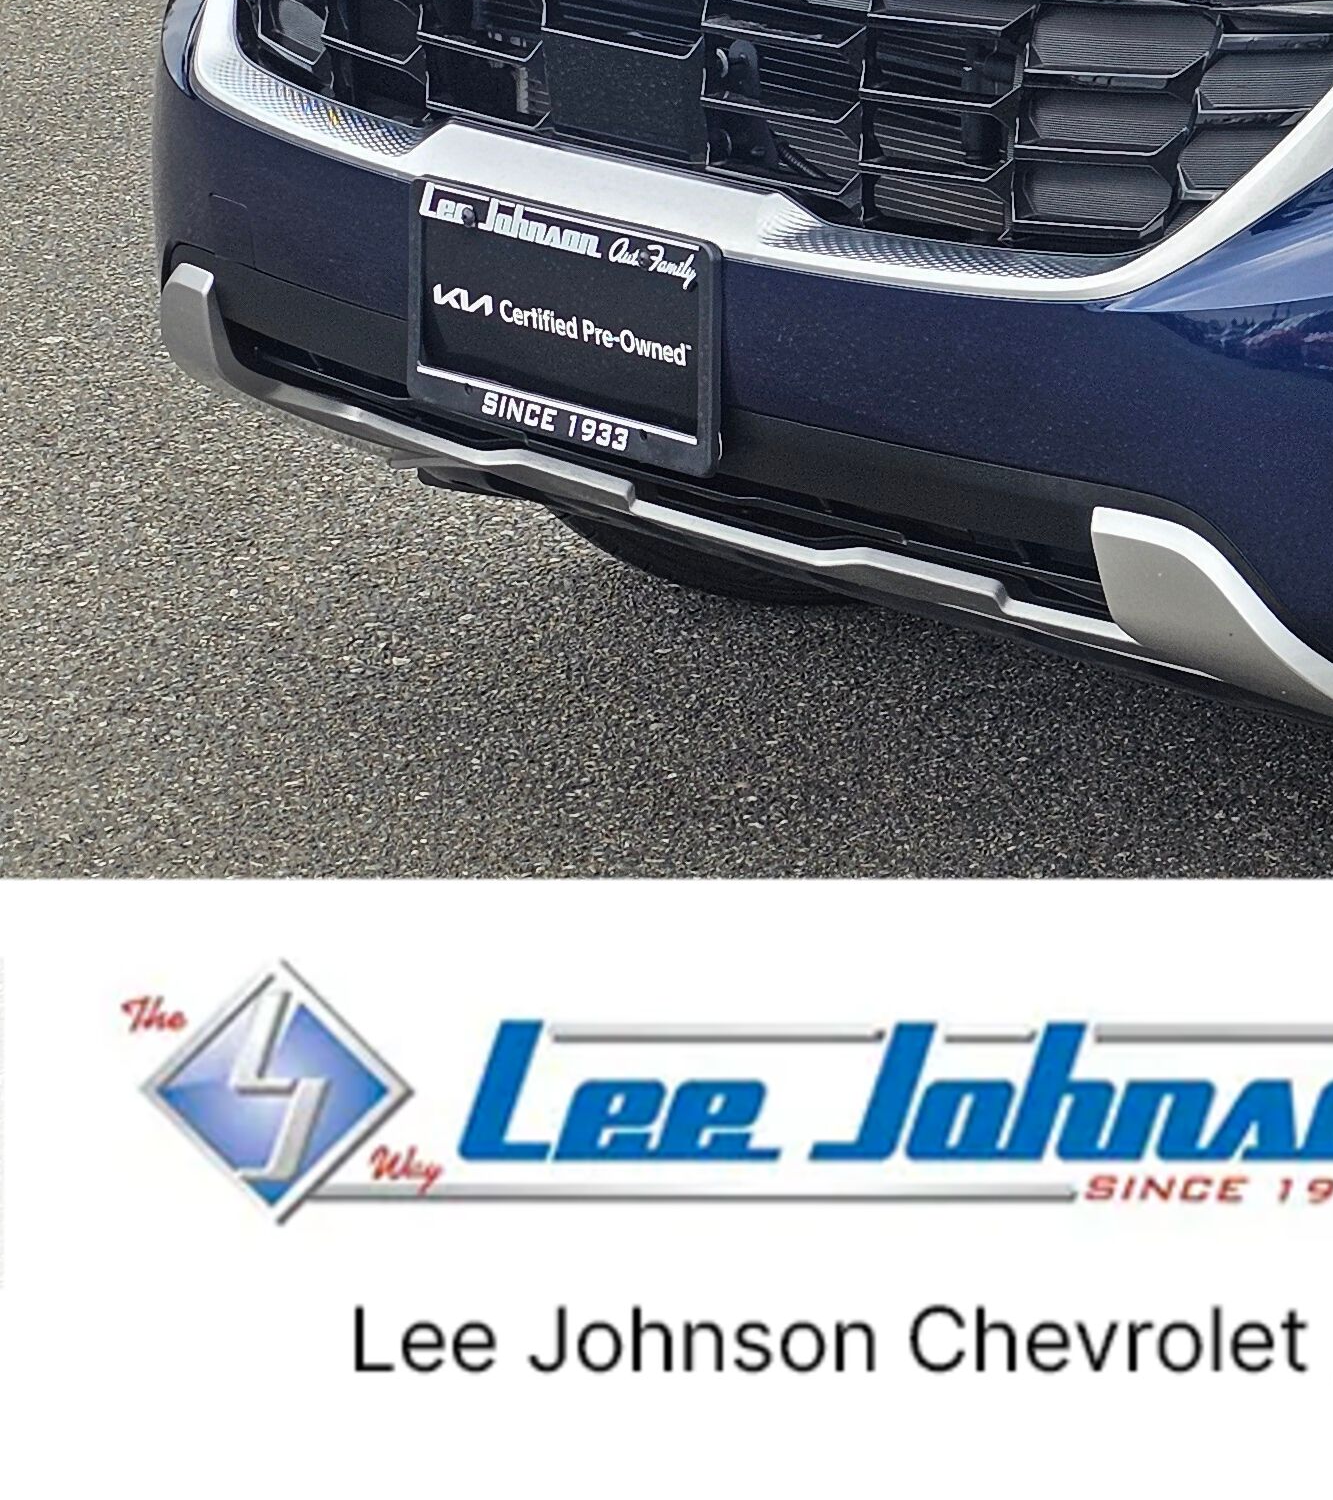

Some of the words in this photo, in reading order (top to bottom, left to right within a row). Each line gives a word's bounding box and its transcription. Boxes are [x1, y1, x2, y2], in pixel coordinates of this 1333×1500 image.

[477, 197, 602, 258] Johnson
[608, 238, 650, 268] Aut
[647, 244, 698, 290] Family
[433, 283, 493, 317] KIA
[499, 299, 579, 341] Certified
[481, 390, 558, 432] SINCE
[567, 414, 630, 451] 1933
